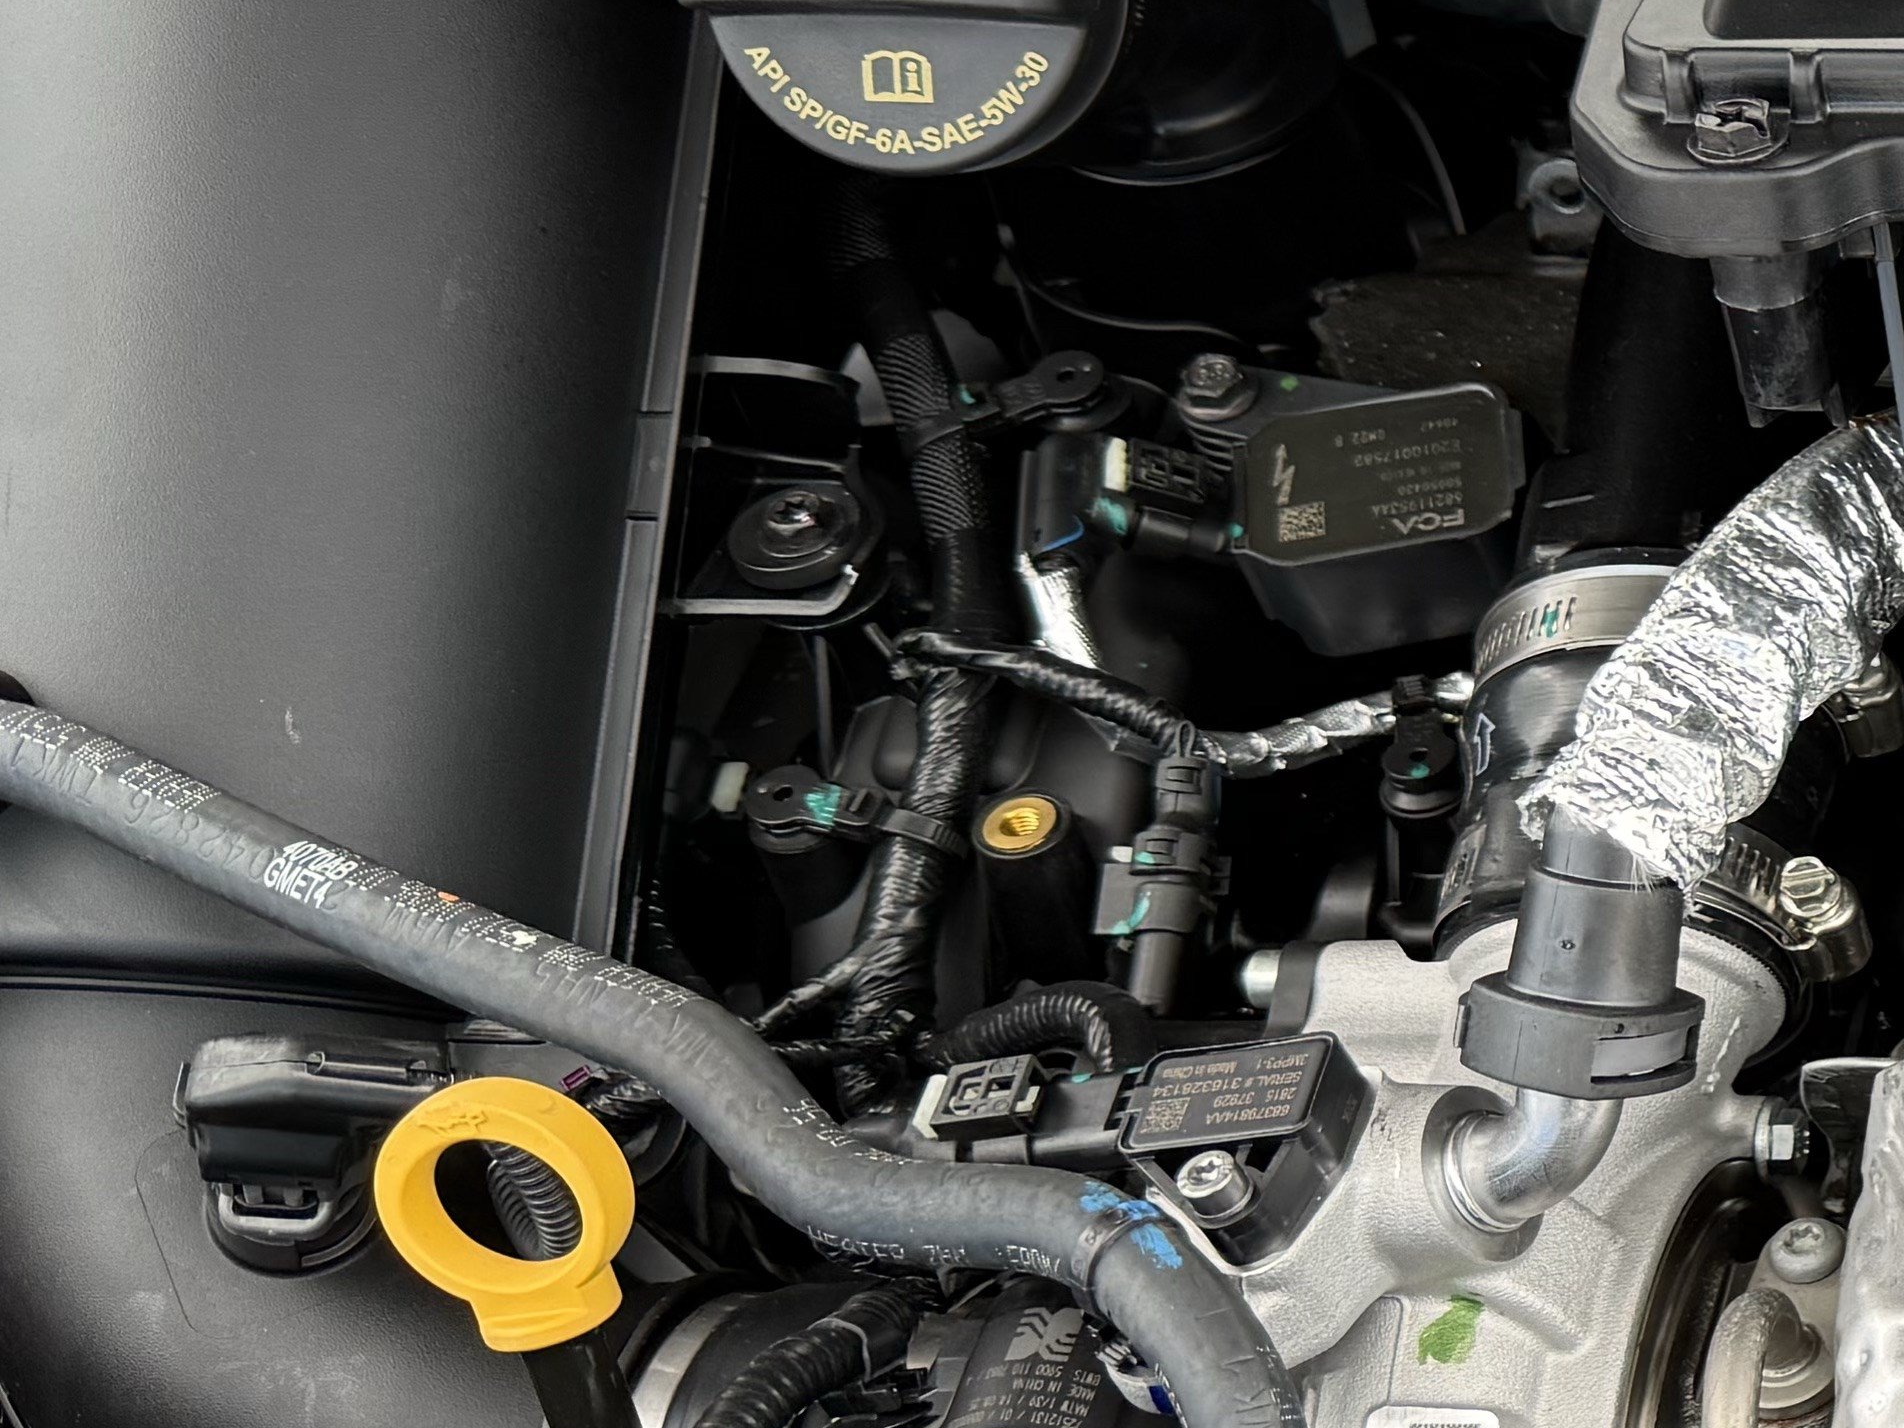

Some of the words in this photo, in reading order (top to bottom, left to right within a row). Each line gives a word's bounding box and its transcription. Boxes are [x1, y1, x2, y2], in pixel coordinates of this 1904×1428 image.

[744, 44, 788, 96] API
[264, 857, 328, 910] GMET4
[282, 840, 359, 882] 4070AB
[1254, 1069, 1303, 1087] SERIAL
